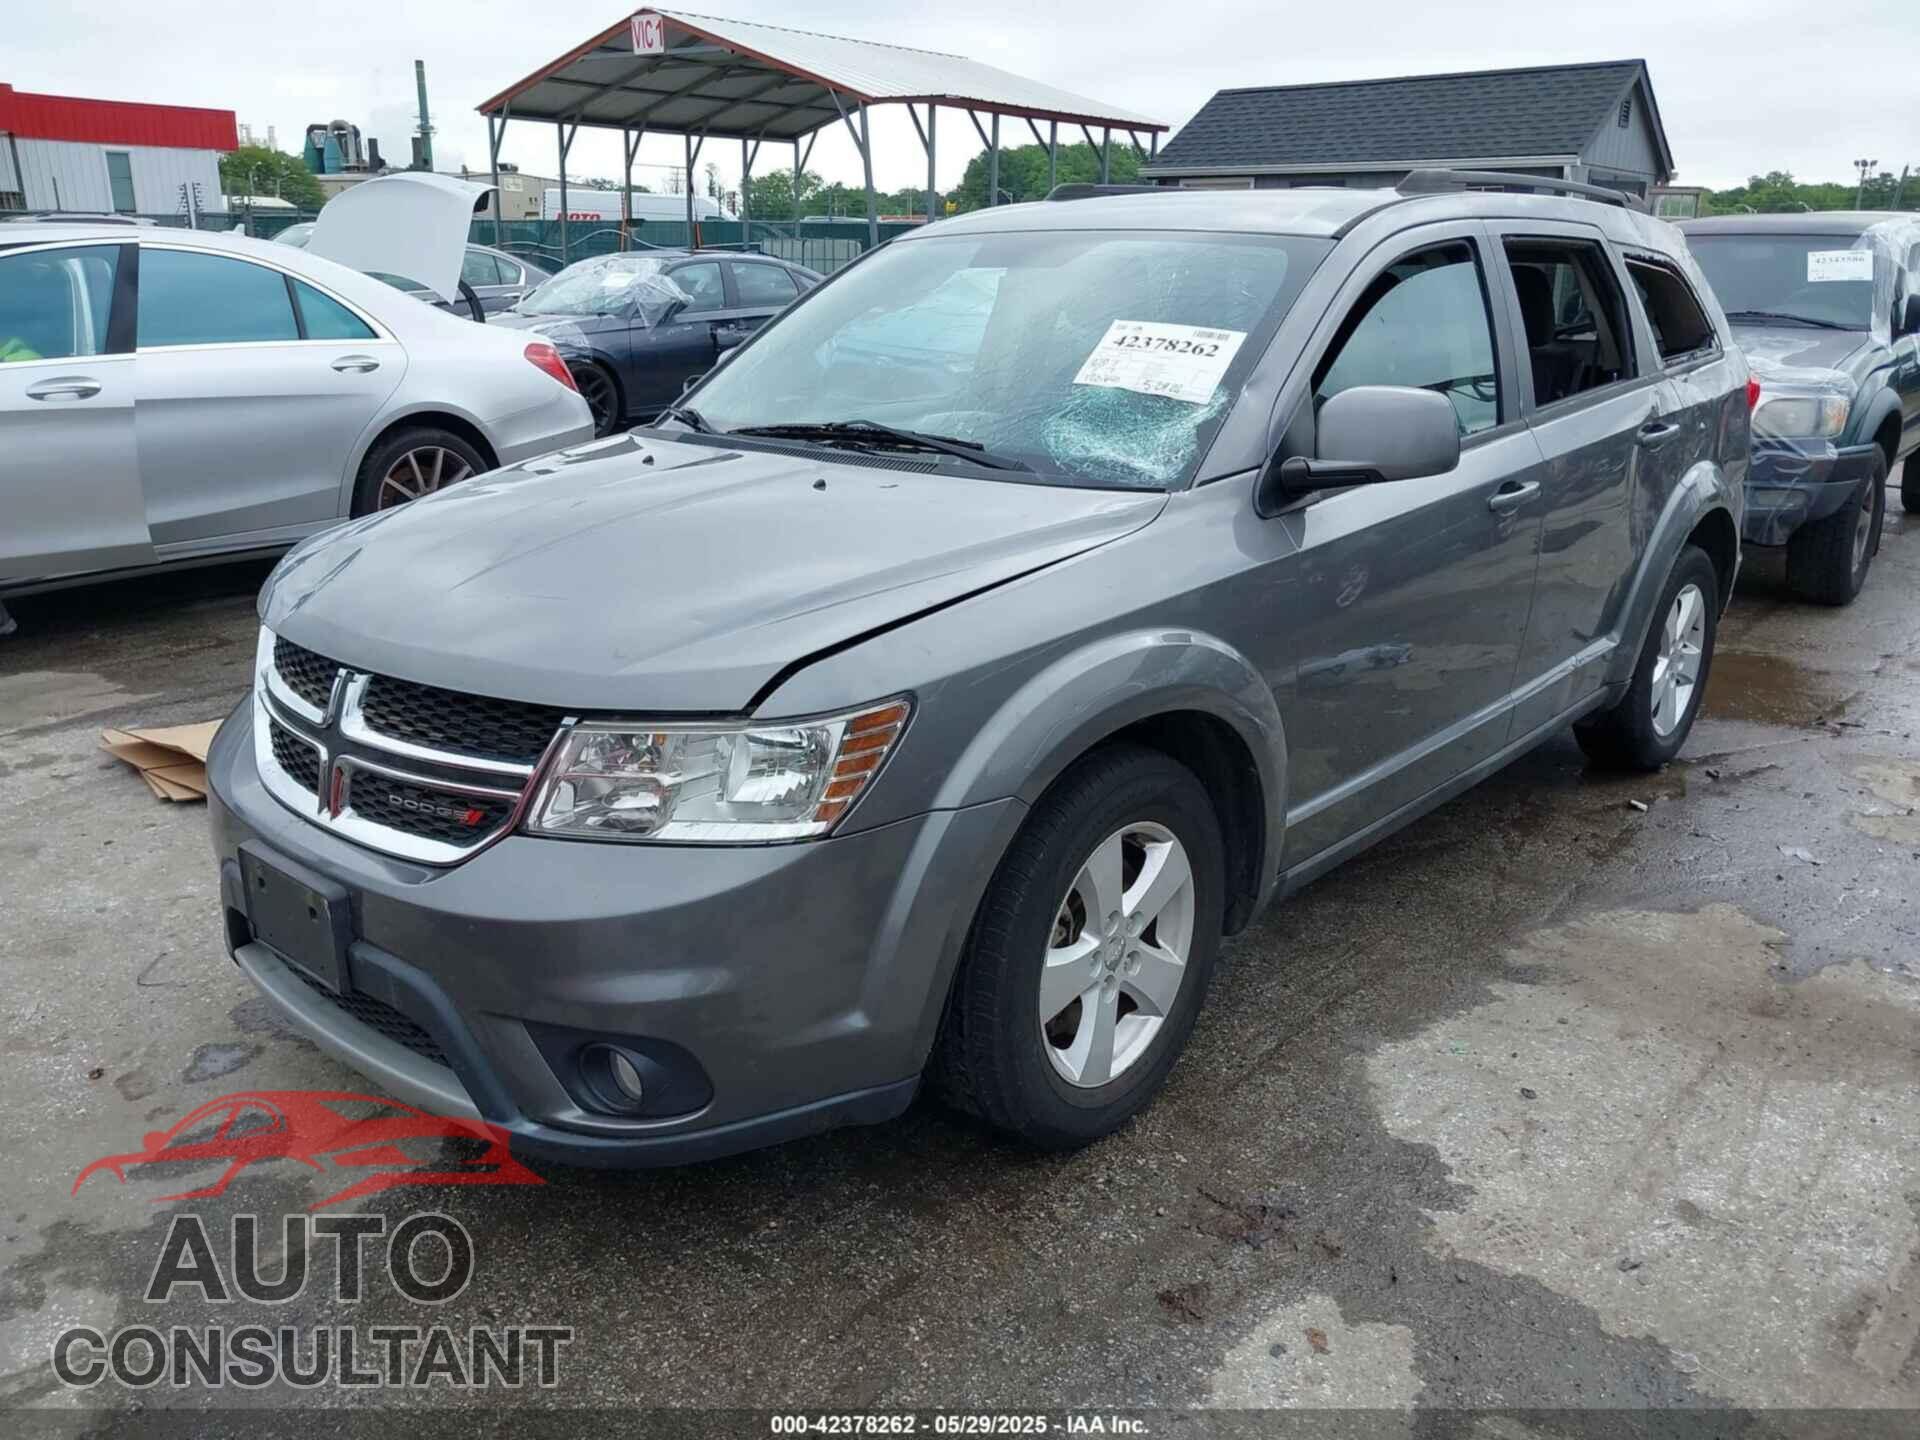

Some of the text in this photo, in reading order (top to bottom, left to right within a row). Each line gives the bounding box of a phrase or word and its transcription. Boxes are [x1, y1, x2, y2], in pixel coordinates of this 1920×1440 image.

[632, 20, 664, 48] VIC 1
[1113, 334, 1220, 358] 42378262
[389, 795, 467, 820] DODGE
